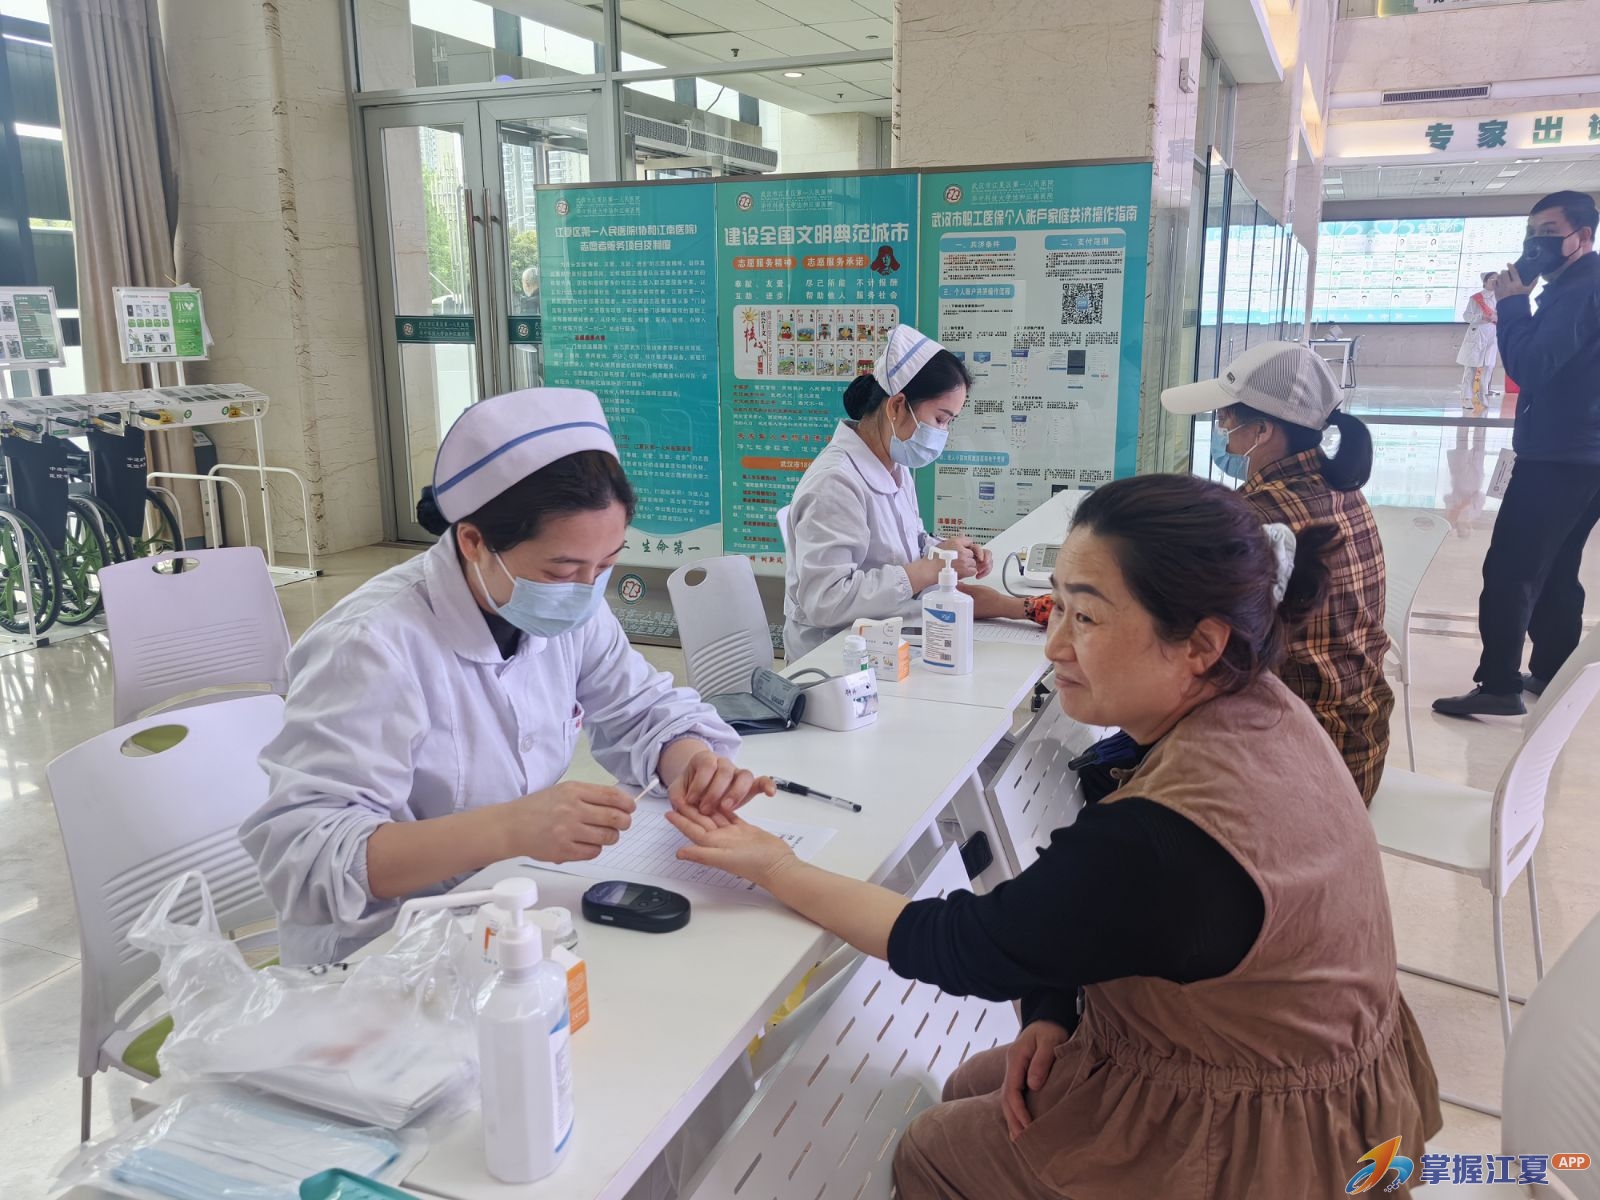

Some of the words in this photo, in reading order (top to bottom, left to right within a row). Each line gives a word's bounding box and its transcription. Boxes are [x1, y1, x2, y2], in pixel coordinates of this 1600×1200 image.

[931, 205, 1138, 228] 武汉市职工医保个人账户家庭共济操作指南
[724, 222, 910, 247] 建设全国文明典范城市
[737, 258, 792, 268] 志愿服务精神
[807, 256, 865, 267] 志愿服务承诺
[856, 290, 898, 300] 服务社会
[642, 538, 701, 556] 生命第一
